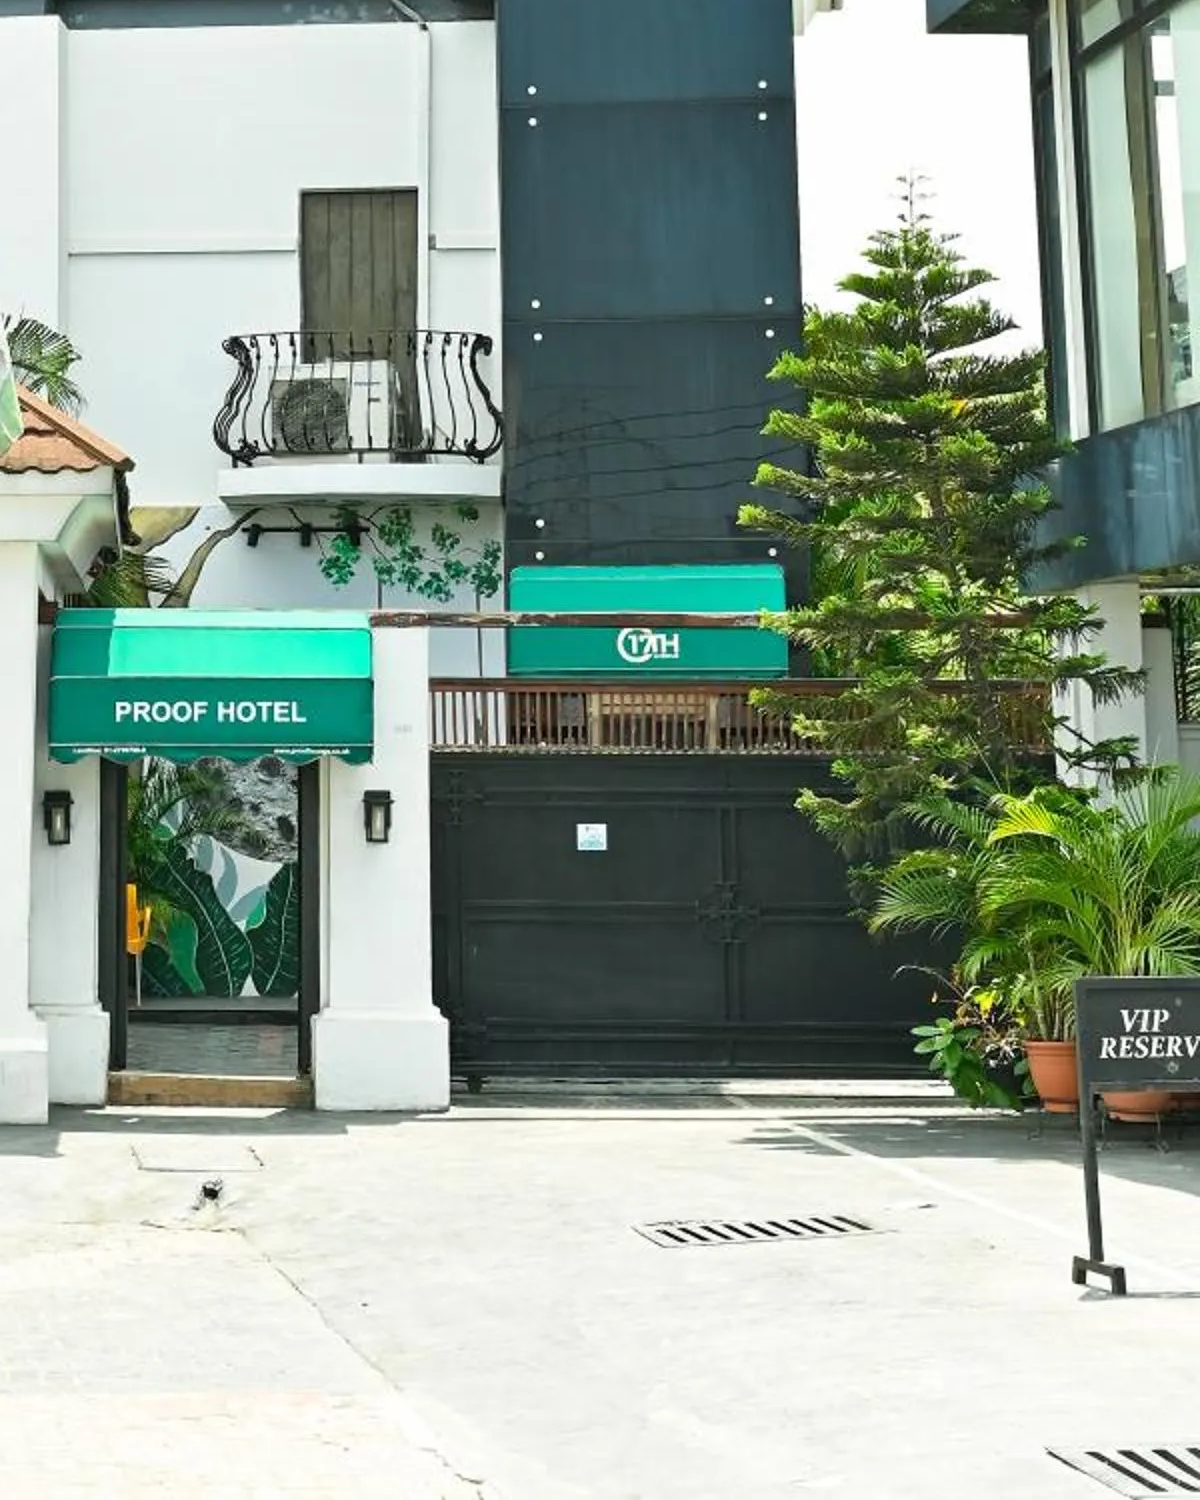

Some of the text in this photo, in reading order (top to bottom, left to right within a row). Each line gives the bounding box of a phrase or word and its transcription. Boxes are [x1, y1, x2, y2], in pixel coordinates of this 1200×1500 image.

[115, 701, 307, 723] PROOF HOTEL
[1120, 1009, 1170, 1033] VIP
